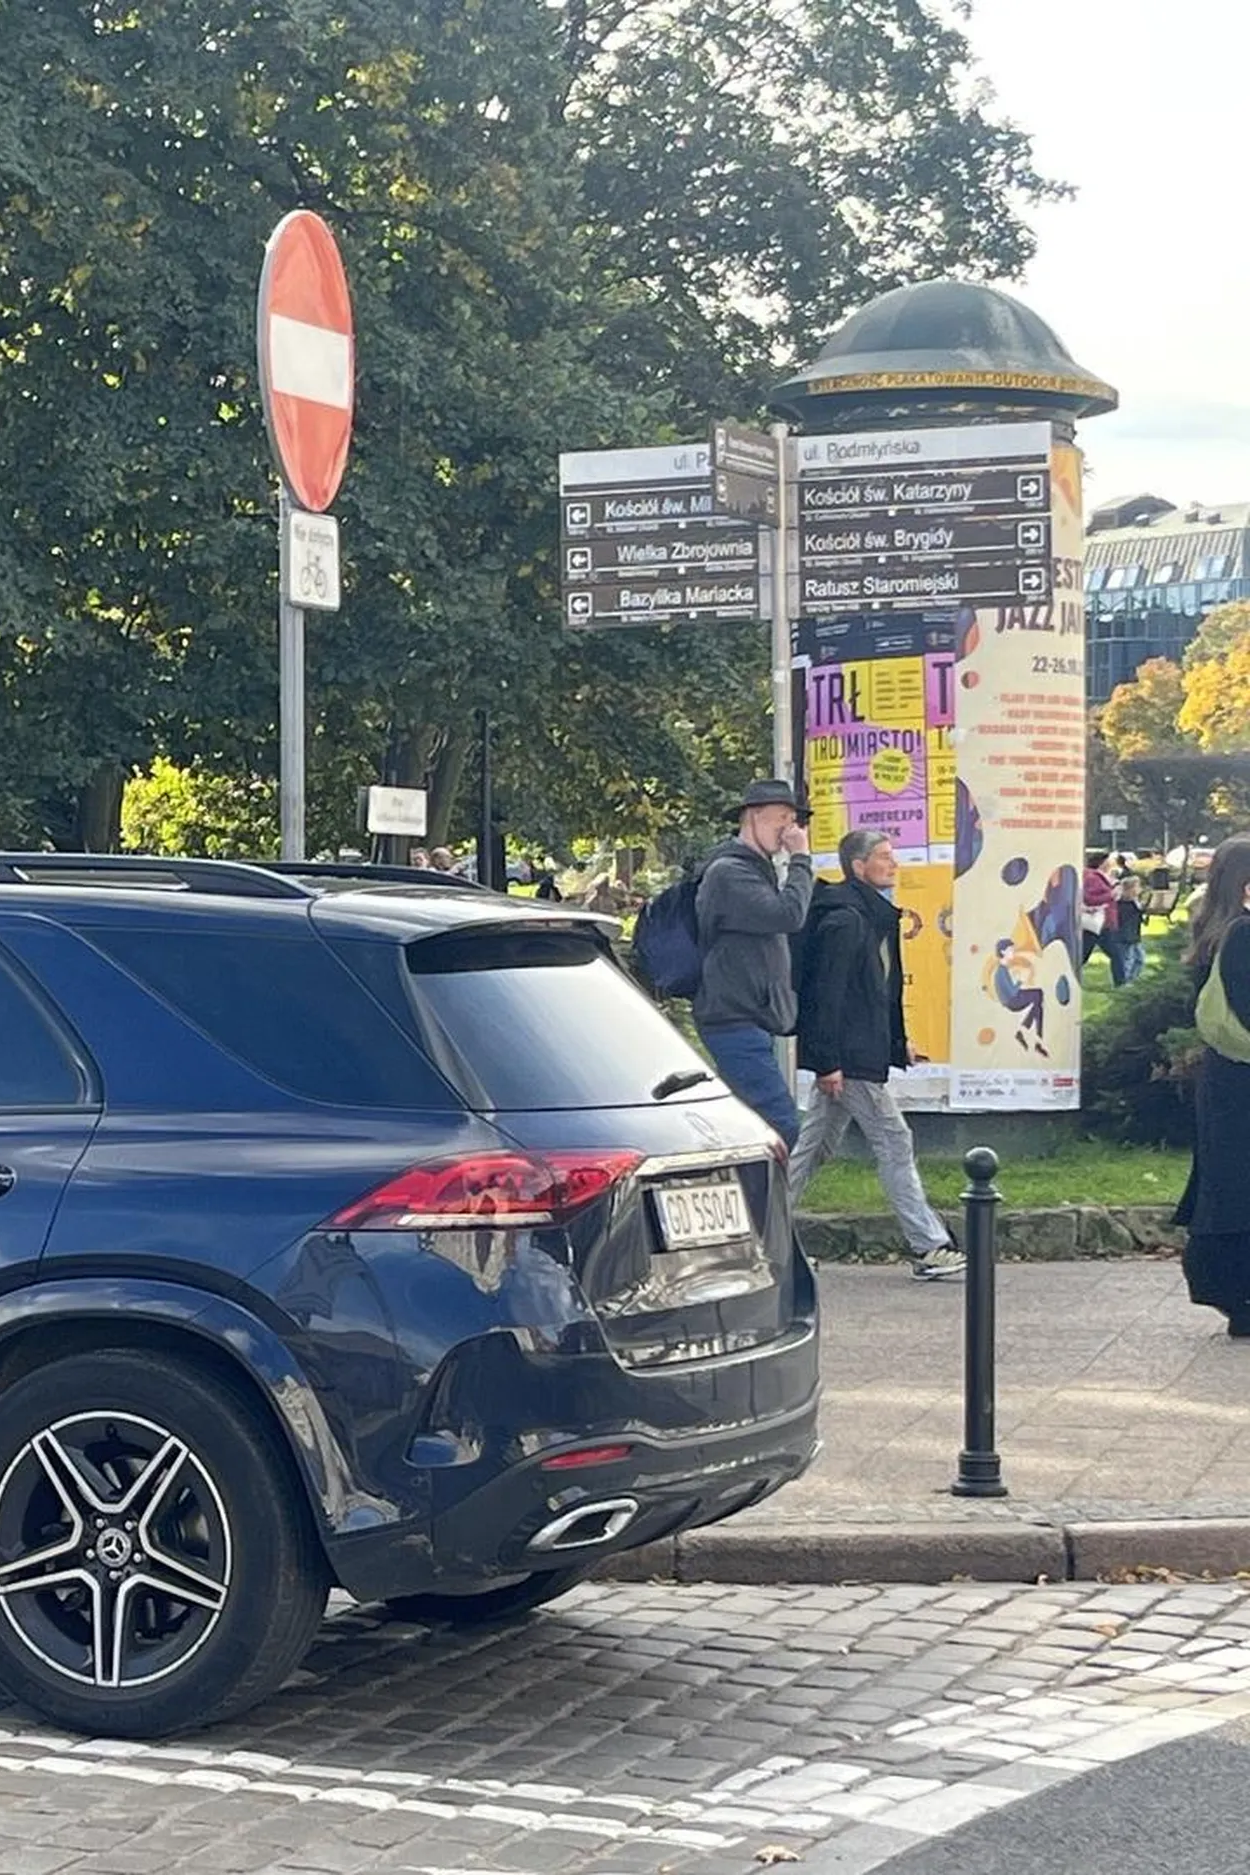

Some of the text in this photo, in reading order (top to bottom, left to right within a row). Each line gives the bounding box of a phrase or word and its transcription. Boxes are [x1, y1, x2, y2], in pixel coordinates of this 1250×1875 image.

[827, 439, 920, 461] Podmłyńska
[804, 481, 973, 506] Kościół św. Katarzyny
[605, 499, 659, 518] Kościół
[662, 499, 686, 515] św.
[617, 540, 753, 563] Wielka Zbrojownia
[804, 529, 954, 552] Kościół św. Brygidy
[620, 584, 754, 610] Bazylika Mariacka
[804, 573, 960, 597] Ratusz Staromiejski
[995, 605, 1055, 634] JAZZ
[666, 1193, 691, 1234] GD
